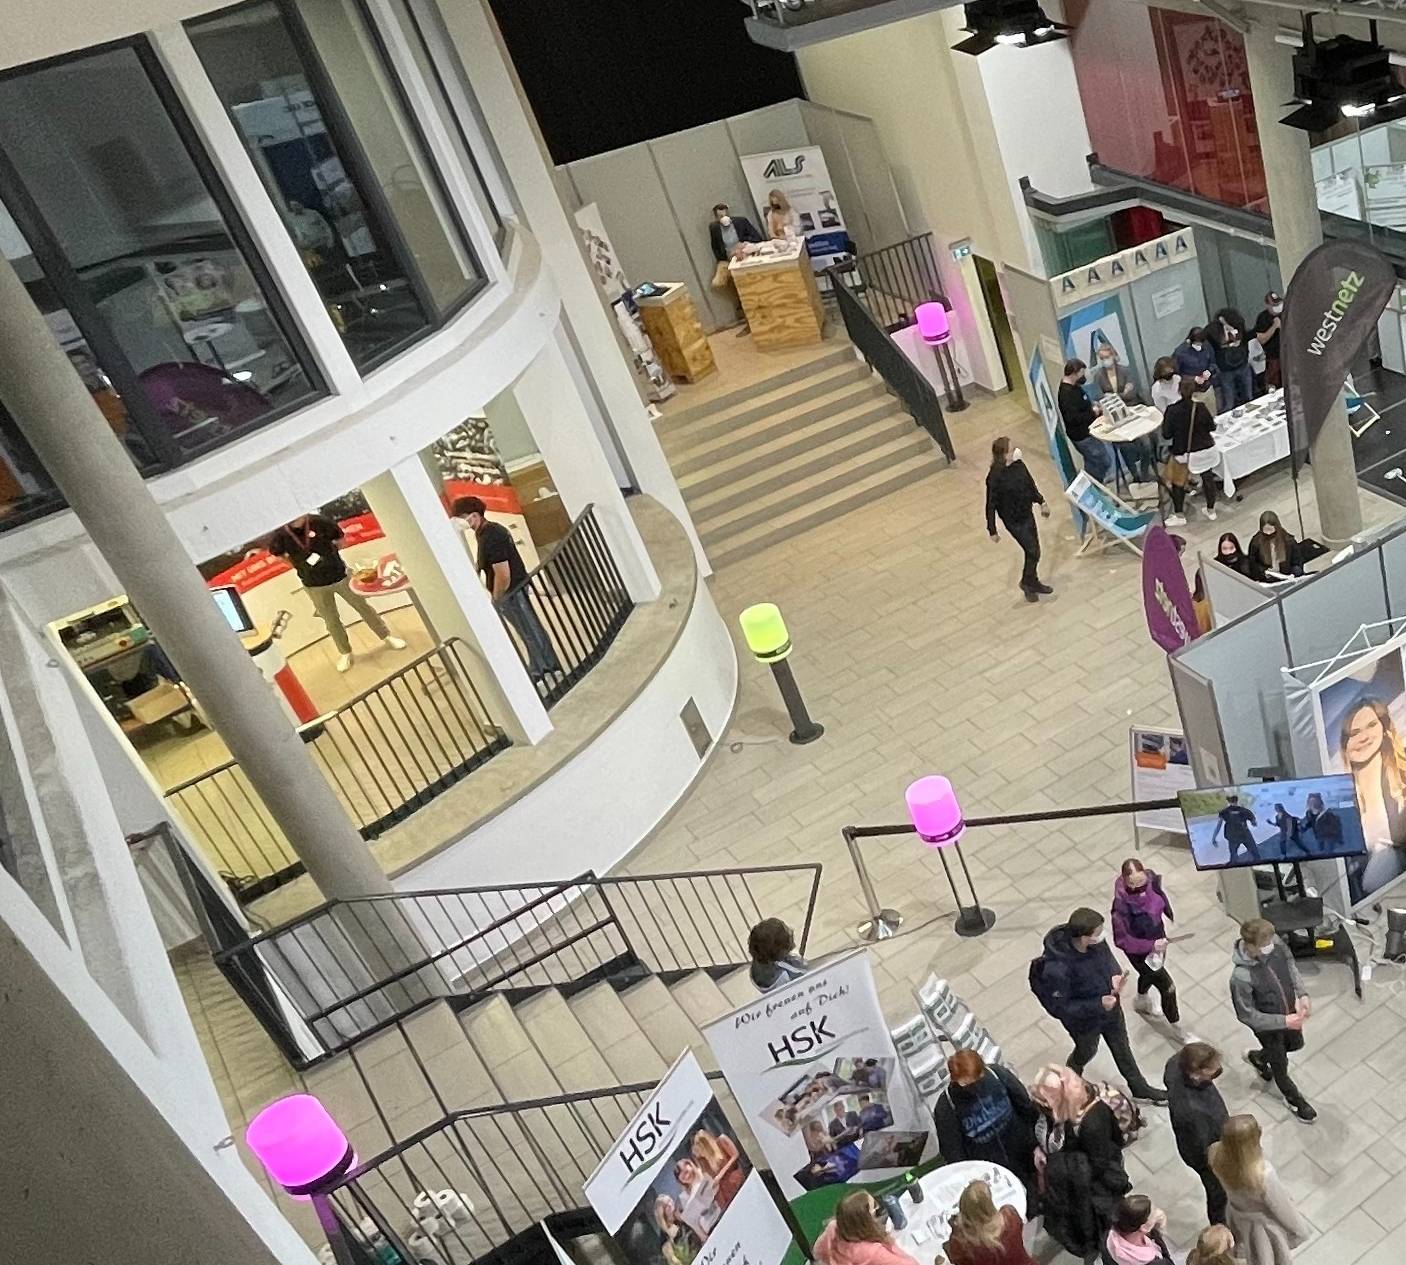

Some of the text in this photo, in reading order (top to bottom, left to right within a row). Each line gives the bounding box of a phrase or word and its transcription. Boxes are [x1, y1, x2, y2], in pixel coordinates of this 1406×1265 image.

[763, 155, 805, 178] ALS
[1307, 271, 1365, 356] westnetz
[768, 1015, 836, 1063] HSK
[619, 1101, 671, 1173] HSK
